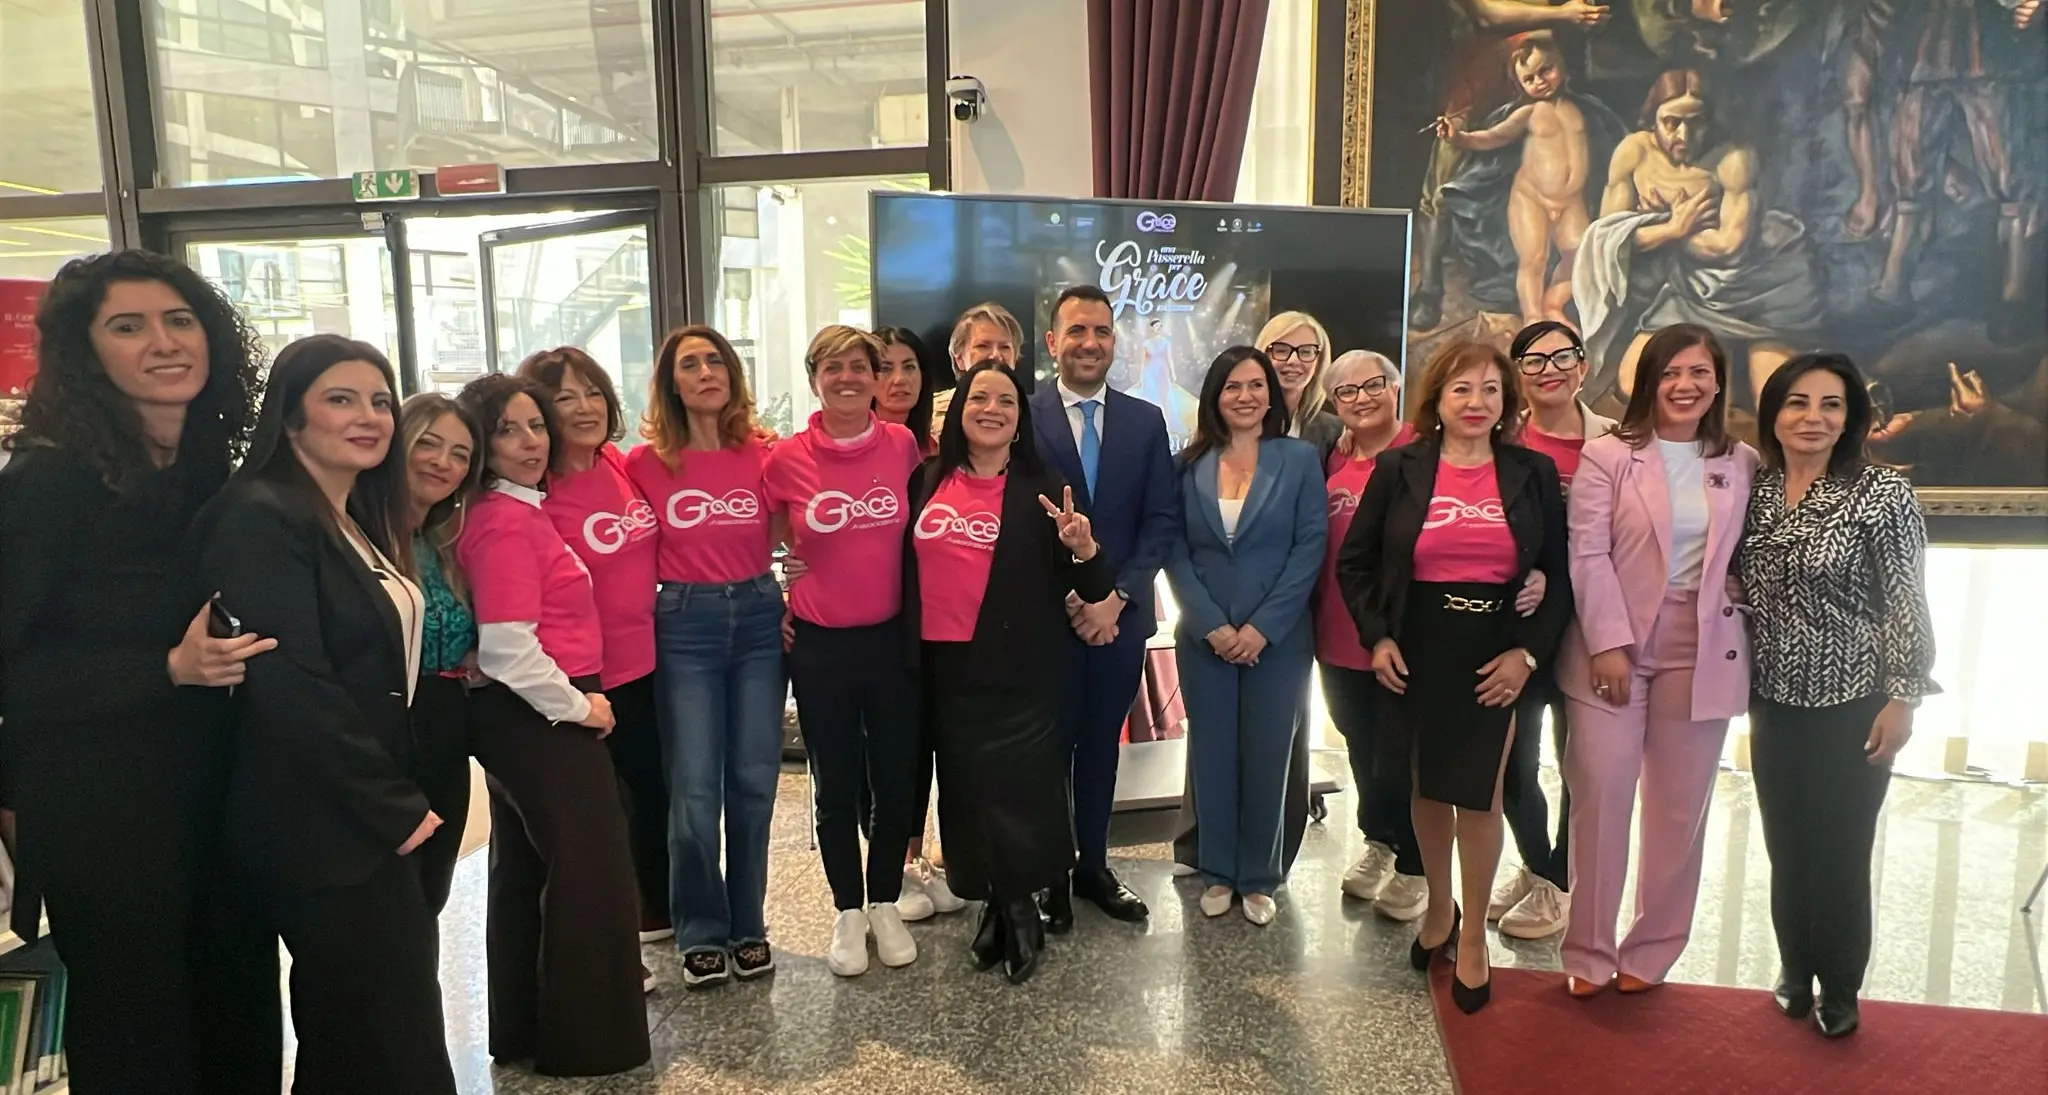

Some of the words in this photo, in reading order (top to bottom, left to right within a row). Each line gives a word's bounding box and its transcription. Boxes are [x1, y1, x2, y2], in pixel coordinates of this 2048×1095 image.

[1146, 249, 1205, 264] Passerella
[1095, 240, 1207, 320] Grace
[583, 499, 657, 554] Grace
[667, 489, 759, 529] Grace
[805, 487, 899, 533] Grace
[914, 503, 1001, 540] Grace
